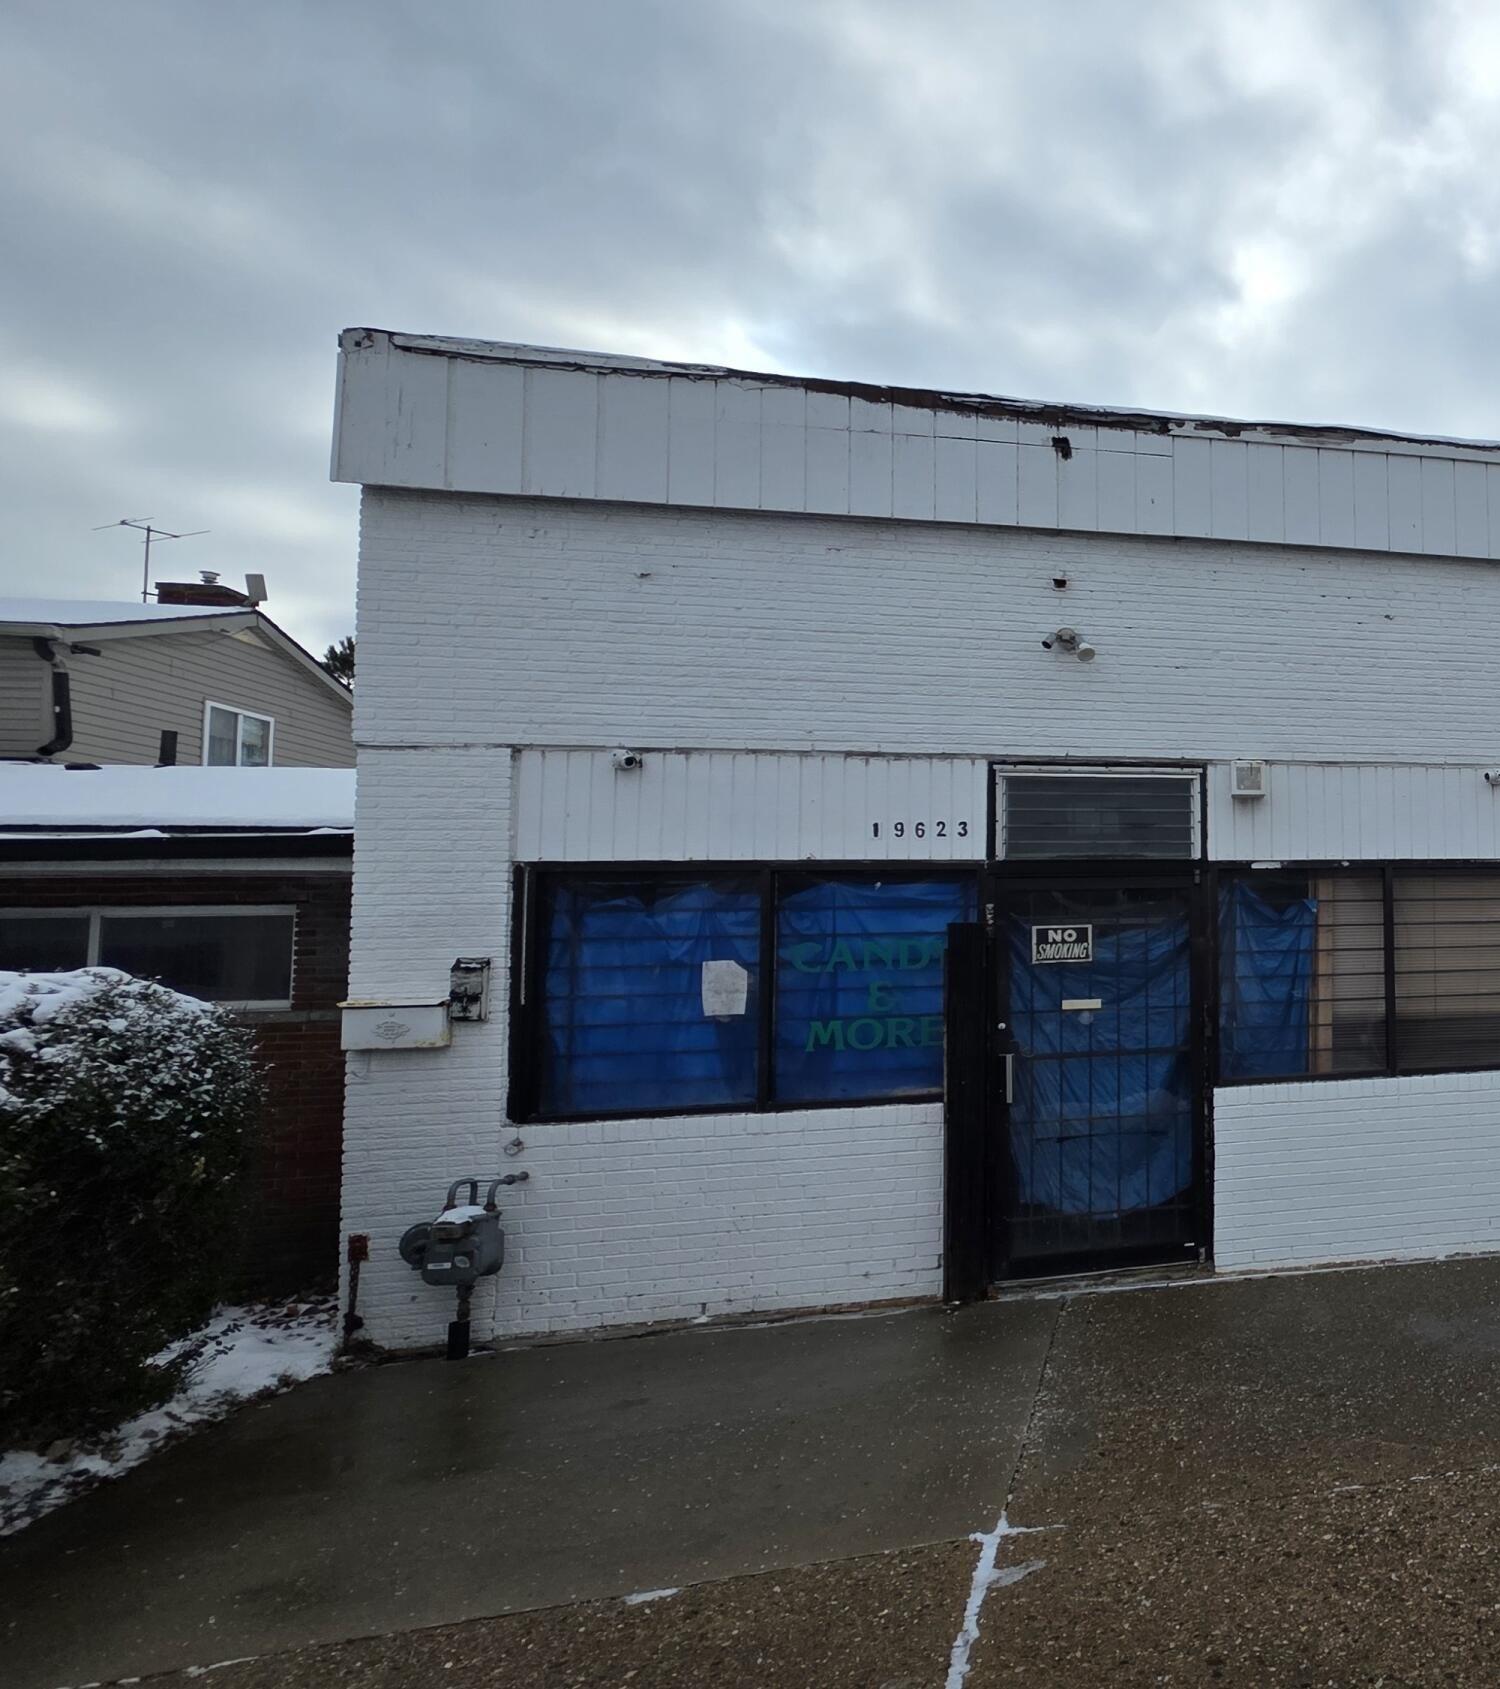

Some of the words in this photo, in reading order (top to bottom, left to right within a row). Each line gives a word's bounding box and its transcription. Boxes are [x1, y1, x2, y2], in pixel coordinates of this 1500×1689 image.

[872, 821, 968, 838] 19623
[1047, 929, 1077, 942] NO
[1036, 942, 1088, 960] SMOKING
[805, 1017, 945, 1052] MORE
